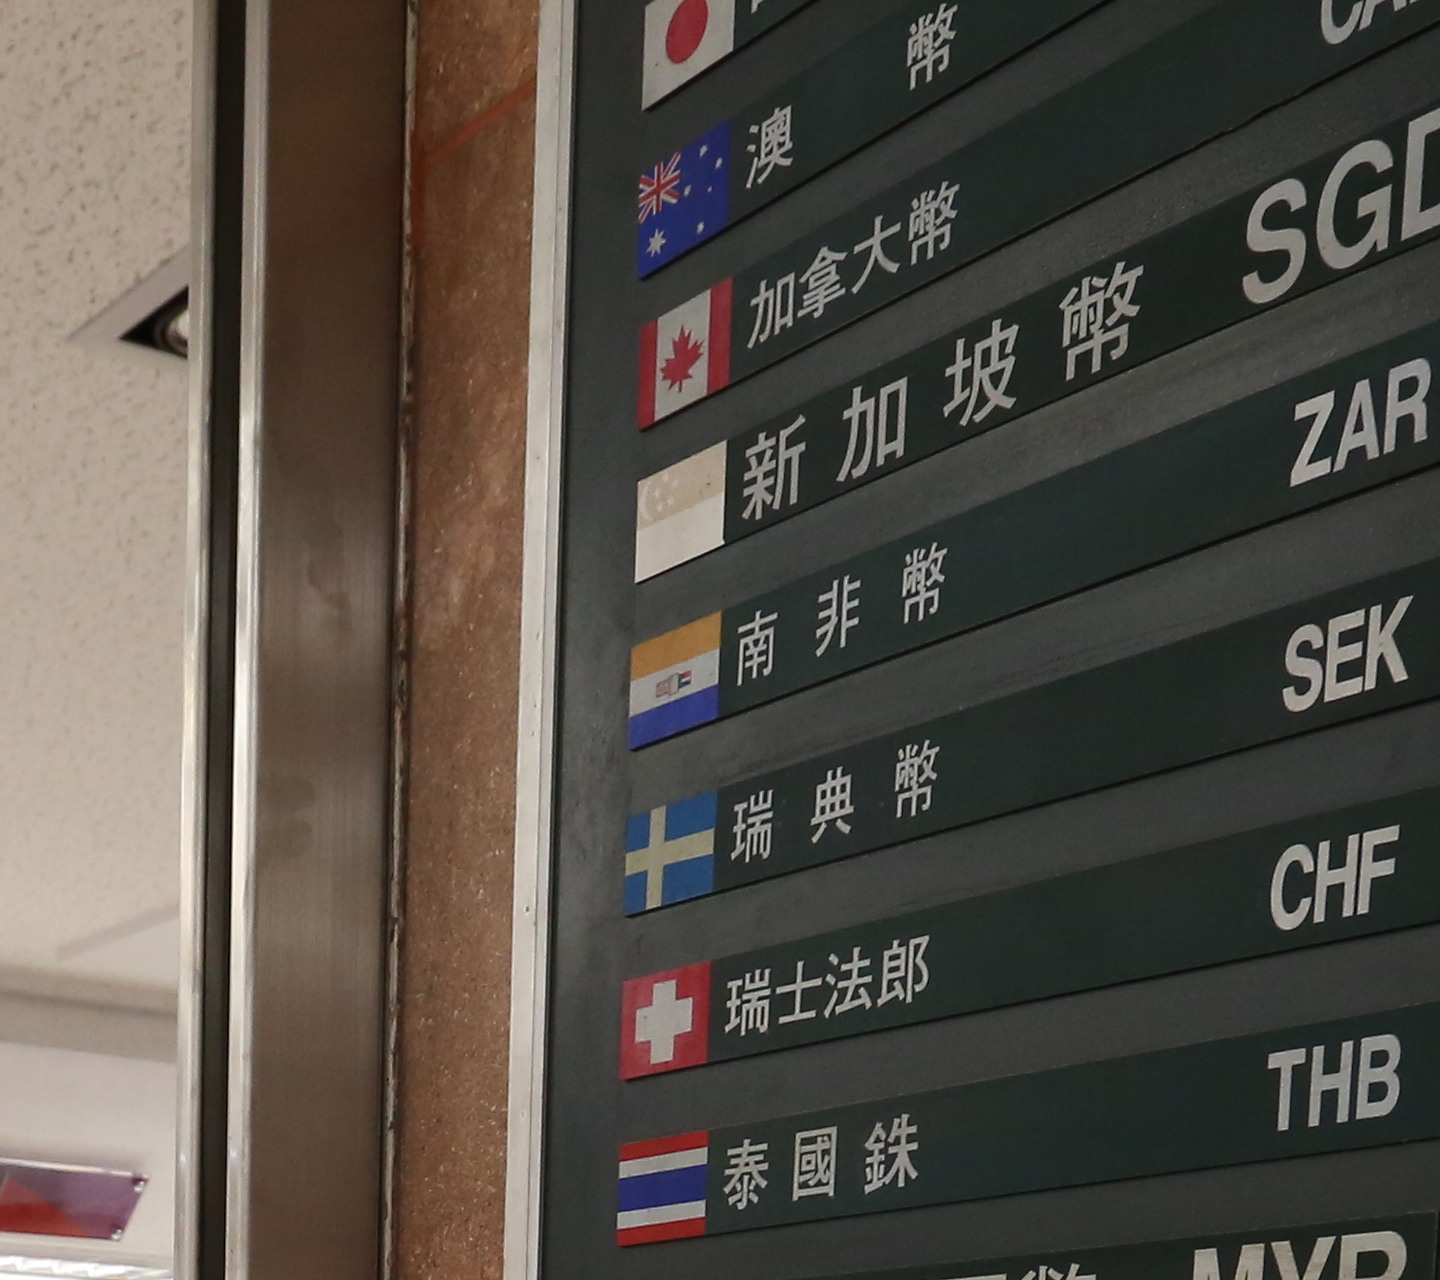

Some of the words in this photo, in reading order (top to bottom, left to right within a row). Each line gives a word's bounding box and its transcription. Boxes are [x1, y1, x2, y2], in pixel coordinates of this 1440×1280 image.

[748, 181, 960, 350] 加拿大幣
[742, 260, 1143, 522] 新加坡幣
[735, 541, 948, 687] 南非幣
[1289, 357, 1431, 487] ZAR
[730, 738, 941, 865] 瑞典幣
[1281, 596, 1415, 713] SEK
[724, 936, 930, 1037] 瑞士法郎
[1269, 824, 1401, 932] CHF
[723, 1113, 919, 1211] 泰國銖
[1267, 1033, 1401, 1131] THB
